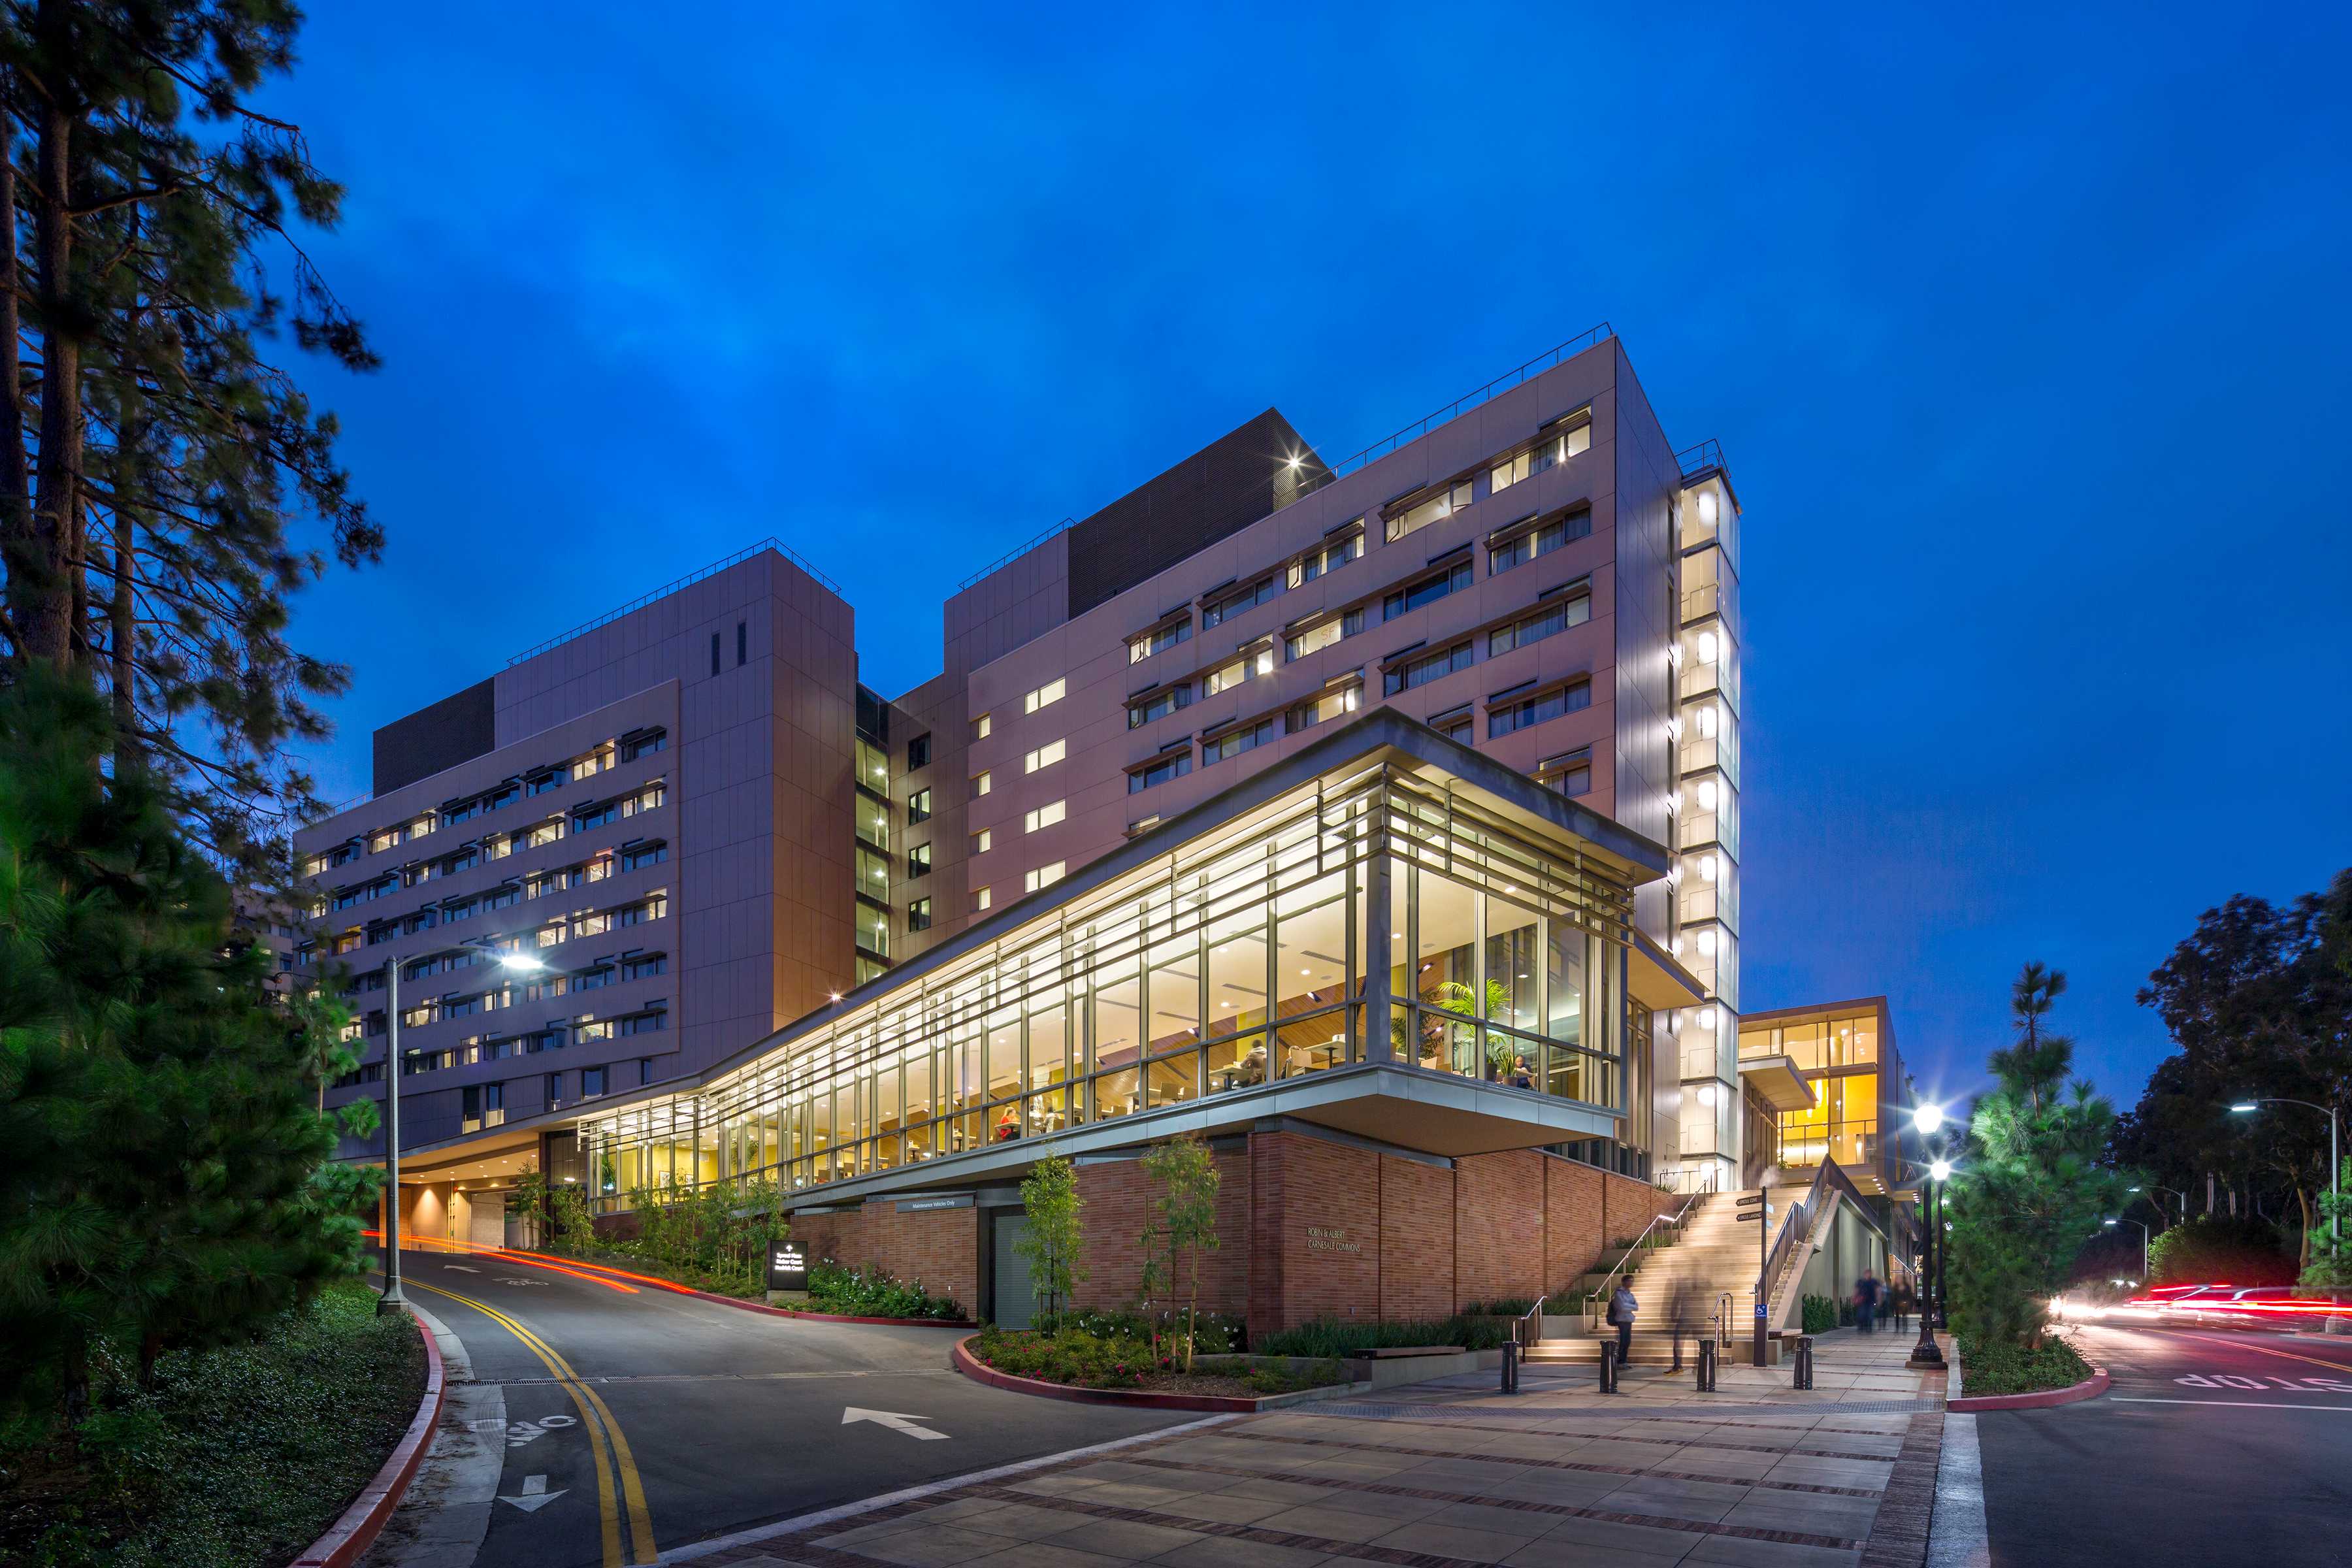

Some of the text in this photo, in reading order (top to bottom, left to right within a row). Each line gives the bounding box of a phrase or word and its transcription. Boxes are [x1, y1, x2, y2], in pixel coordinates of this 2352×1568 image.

[1308, 1228, 1345, 1239] ROBIN & ALBERT
[1308, 1240, 1360, 1252] CARNESALE COMMONS
[2173, 1374, 2352, 1392] STOP
